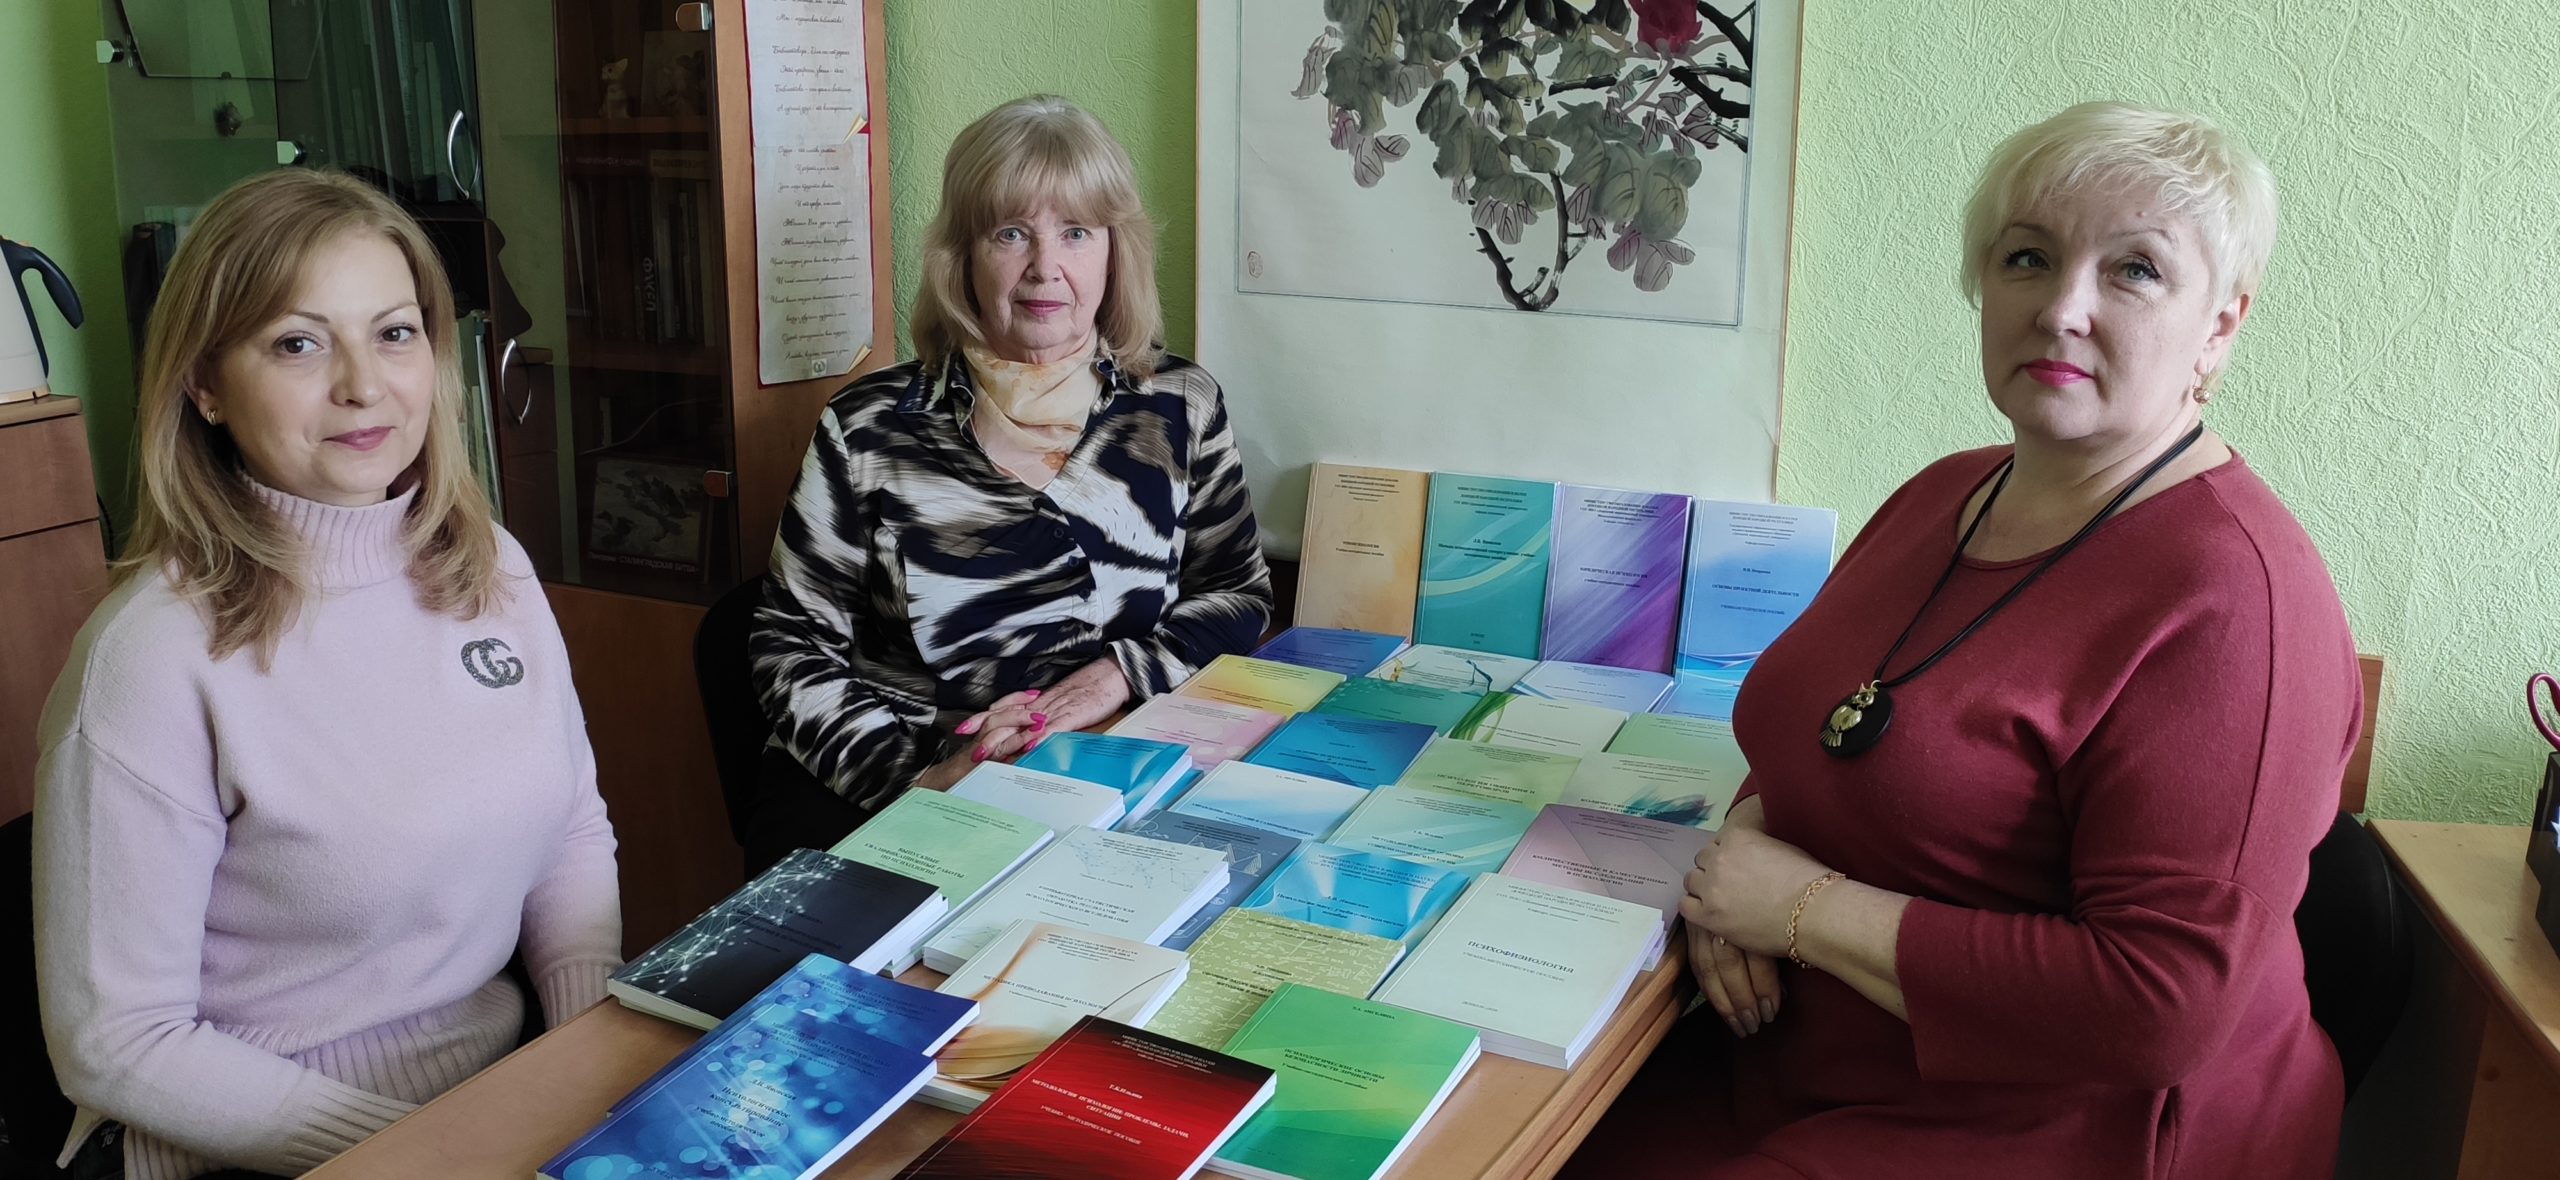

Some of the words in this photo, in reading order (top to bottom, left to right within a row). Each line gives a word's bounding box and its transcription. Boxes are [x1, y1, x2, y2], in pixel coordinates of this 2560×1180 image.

[1467, 940, 1575, 974] ПСИХОФИЗИОЛОГИЯ
[1354, 1067, 1385, 1080] ОСНОВЫ
[721, 1086, 792, 1119] Психологическое
